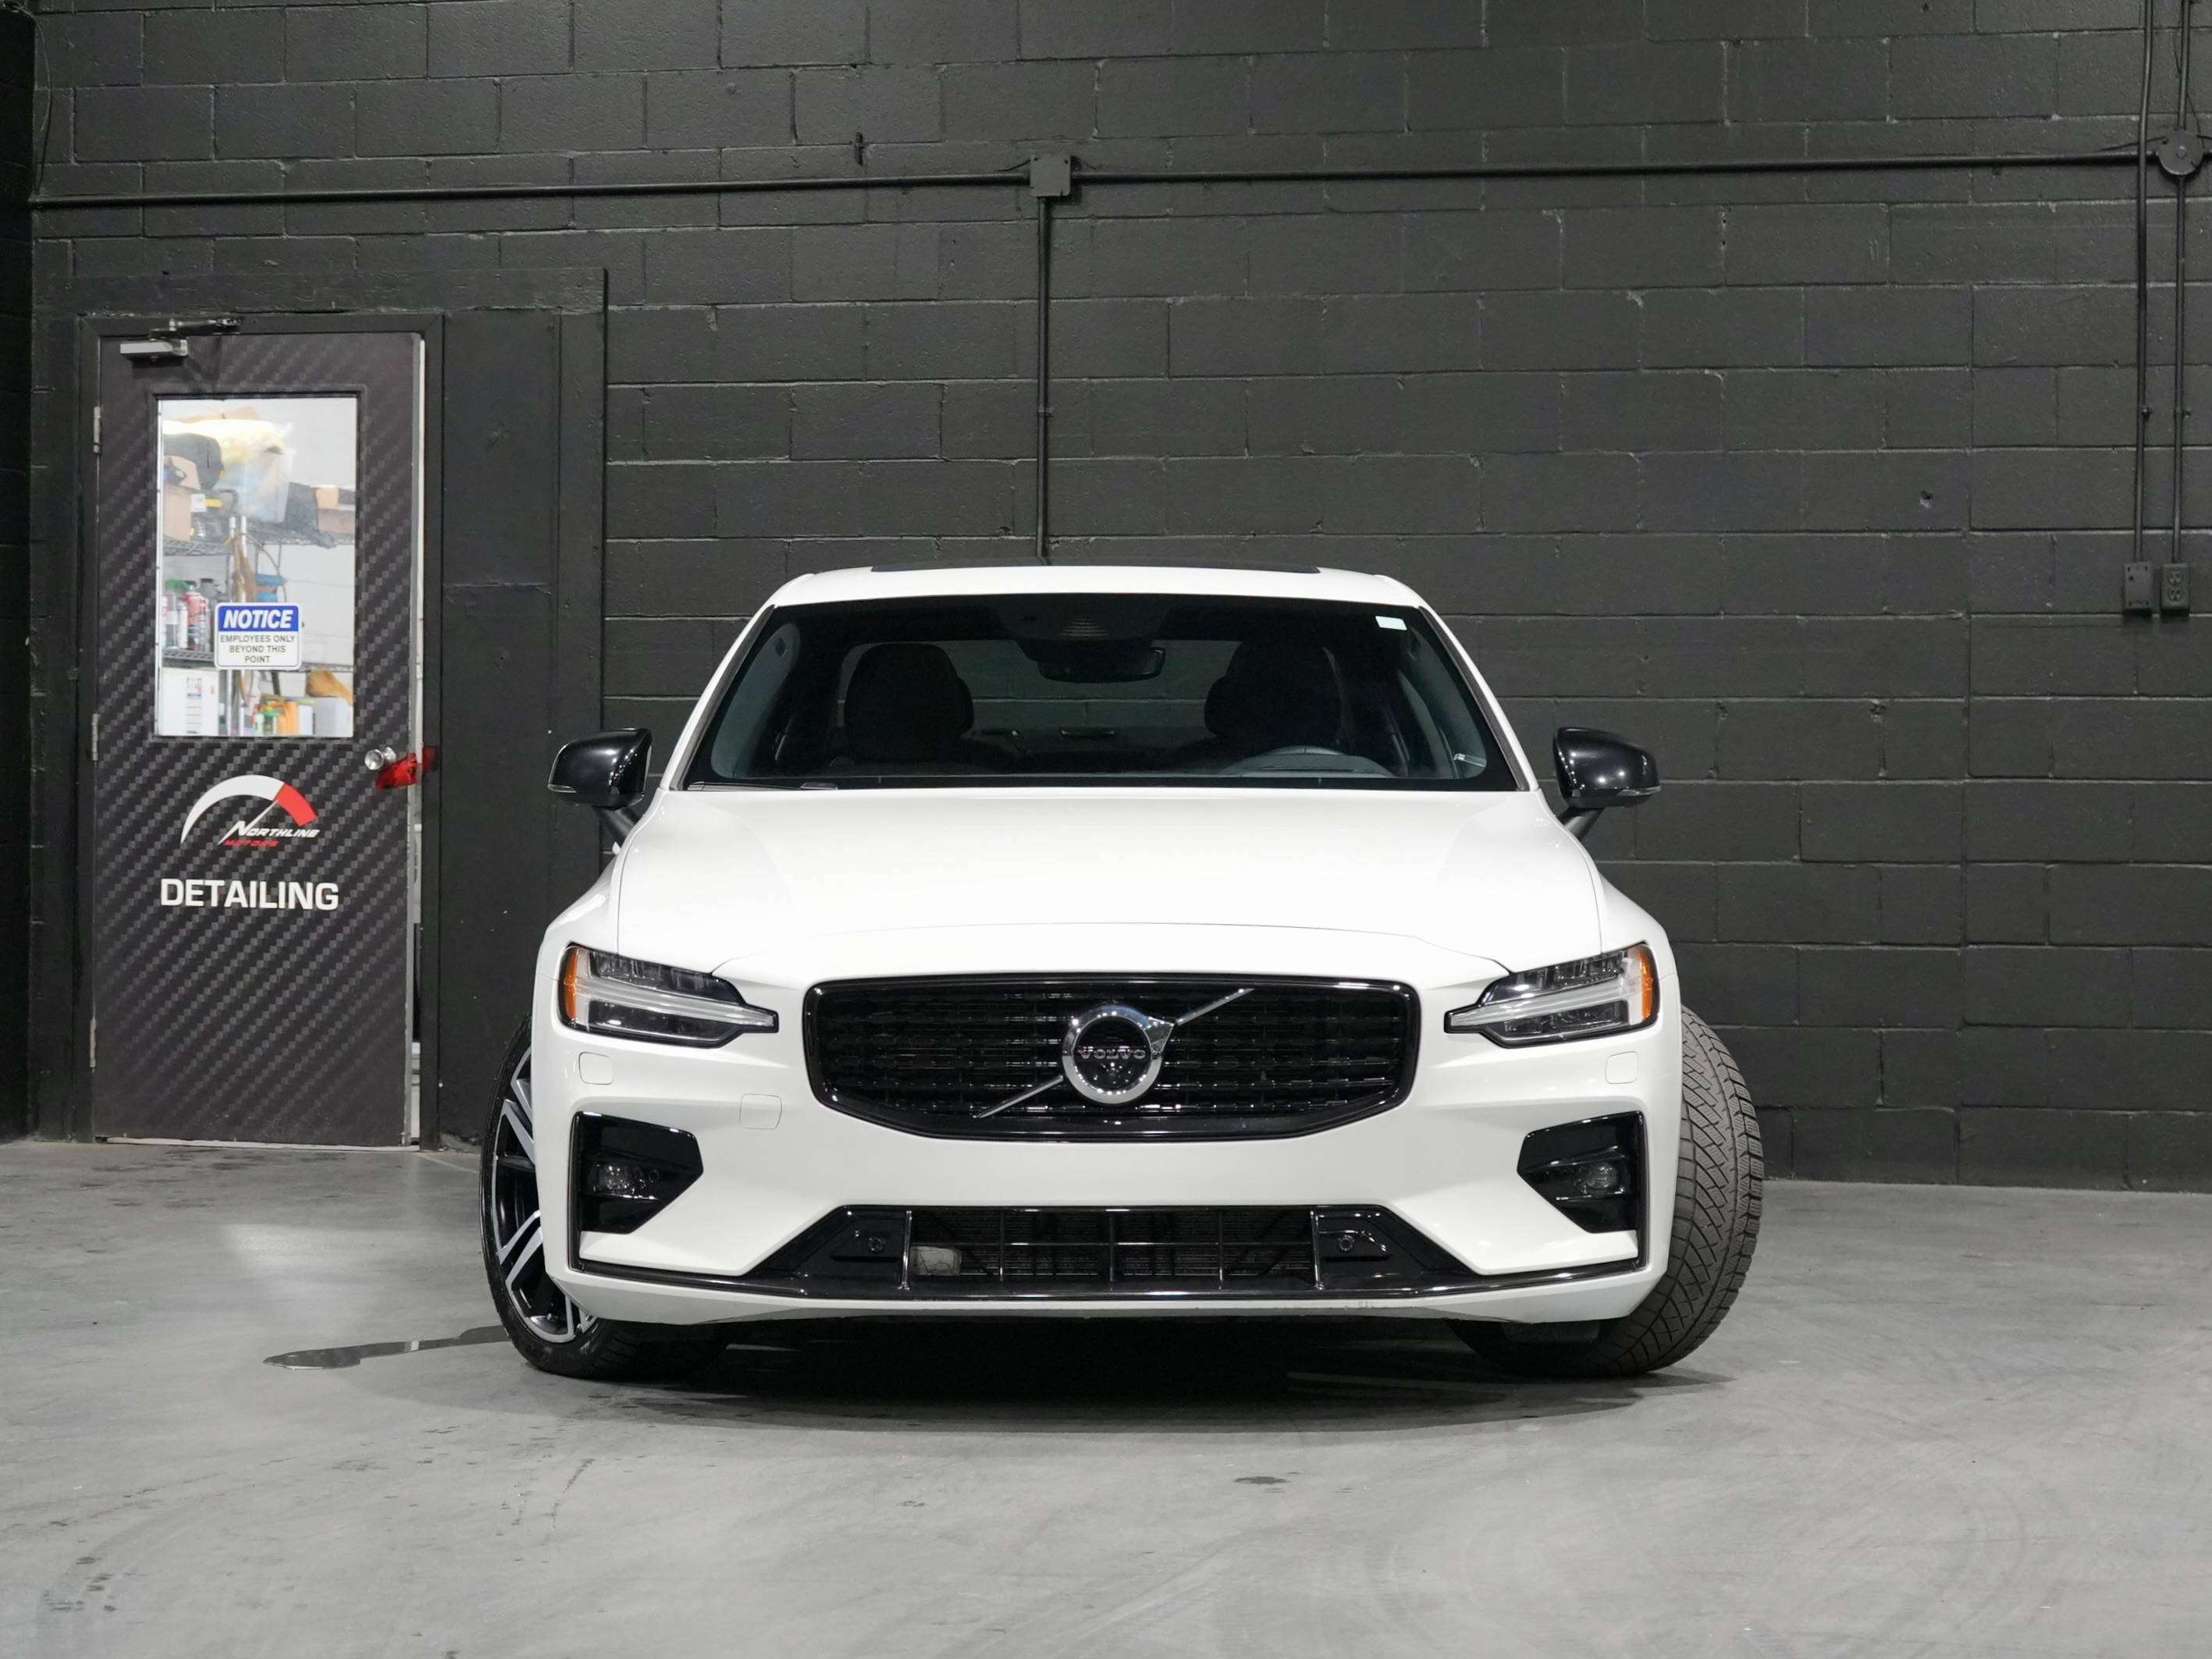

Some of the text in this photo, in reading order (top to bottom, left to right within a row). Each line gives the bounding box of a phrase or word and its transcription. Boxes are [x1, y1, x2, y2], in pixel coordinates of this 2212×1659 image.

[222, 609, 293, 629] NOTICE
[220, 634, 295, 643] EMPLOYEES ONLY
[219, 820, 320, 844] NORTHLINE
[160, 878, 340, 911] DETAILING
[1078, 1048, 1146, 1060] VOLVO
